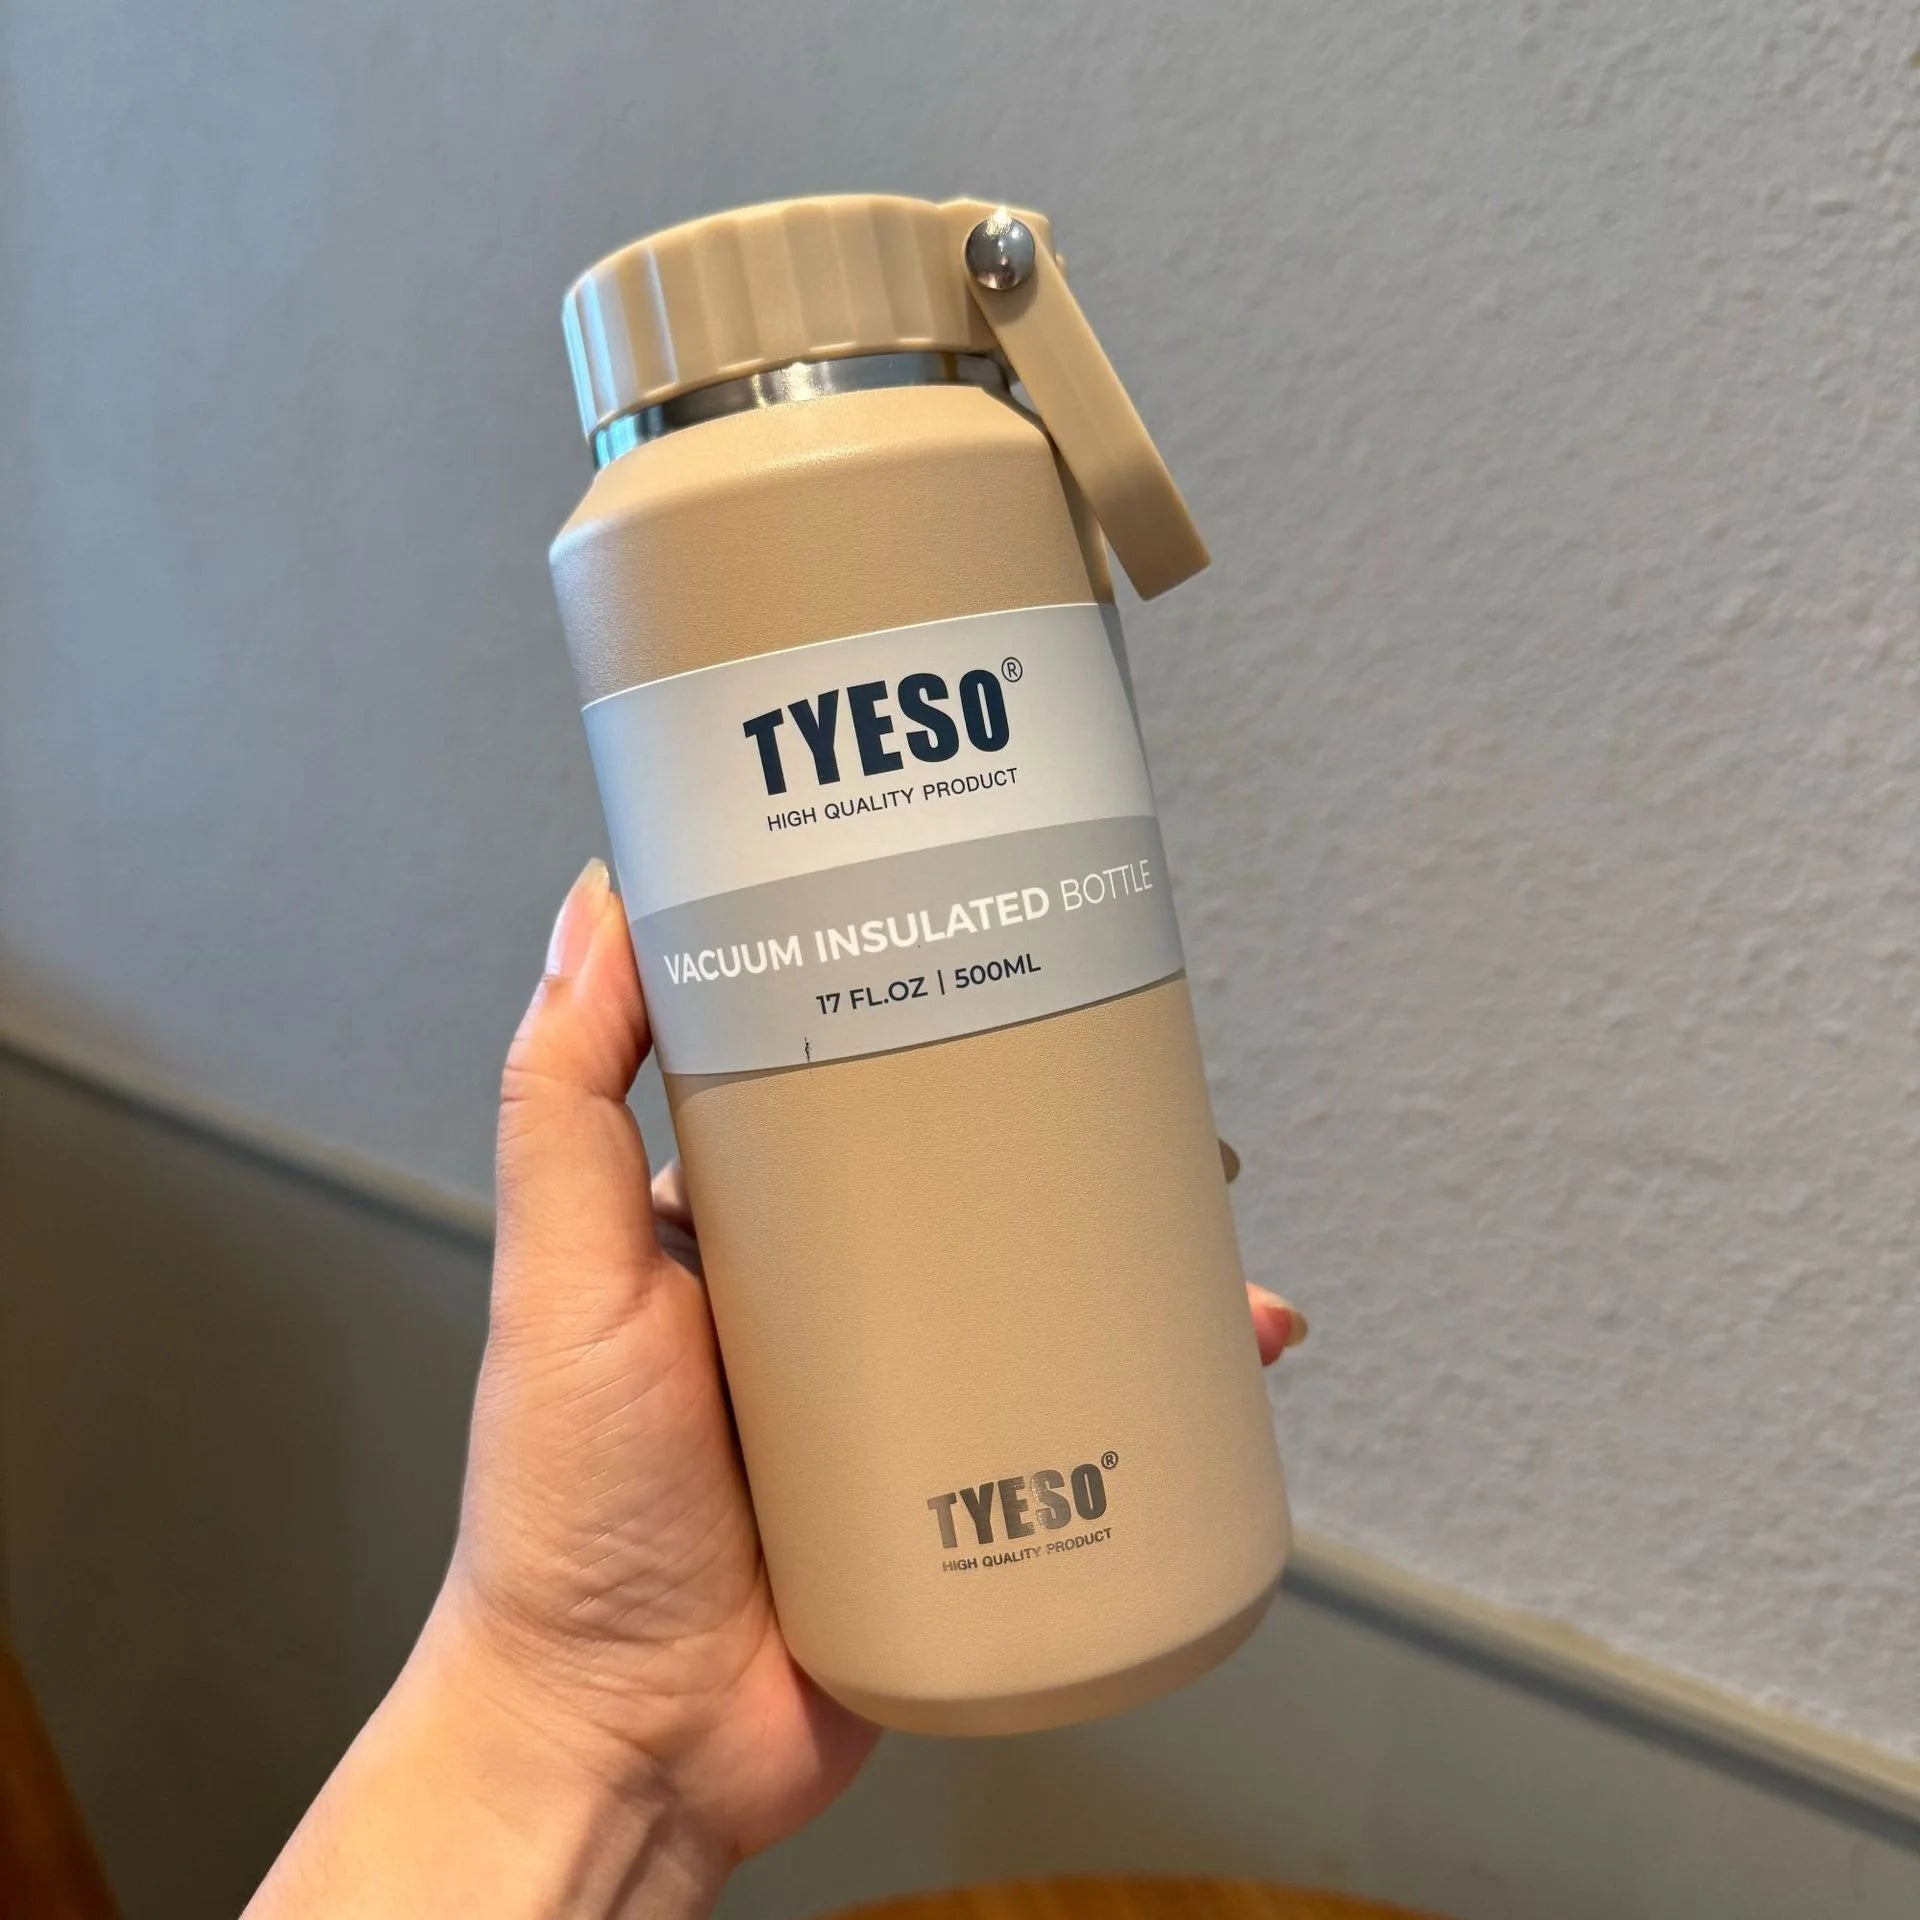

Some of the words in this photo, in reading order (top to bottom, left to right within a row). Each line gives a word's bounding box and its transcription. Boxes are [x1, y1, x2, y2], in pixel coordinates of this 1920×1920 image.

[767, 807, 817, 832] HIGH
[824, 787, 915, 821] QUALITY
[922, 767, 1019, 801] PRODUCT
[664, 935, 803, 985] VACUUM
[815, 886, 1050, 963] INSULATED
[1060, 859, 1153, 912] BOTTLE
[816, 992, 841, 1015] 17
[850, 976, 929, 1010] FL.OZ
[954, 952, 1042, 989] 500ML
[942, 1557, 978, 1572] HIGH
[982, 1546, 1042, 1568] QUALITY
[1046, 1527, 1112, 1555] PRODUCT
